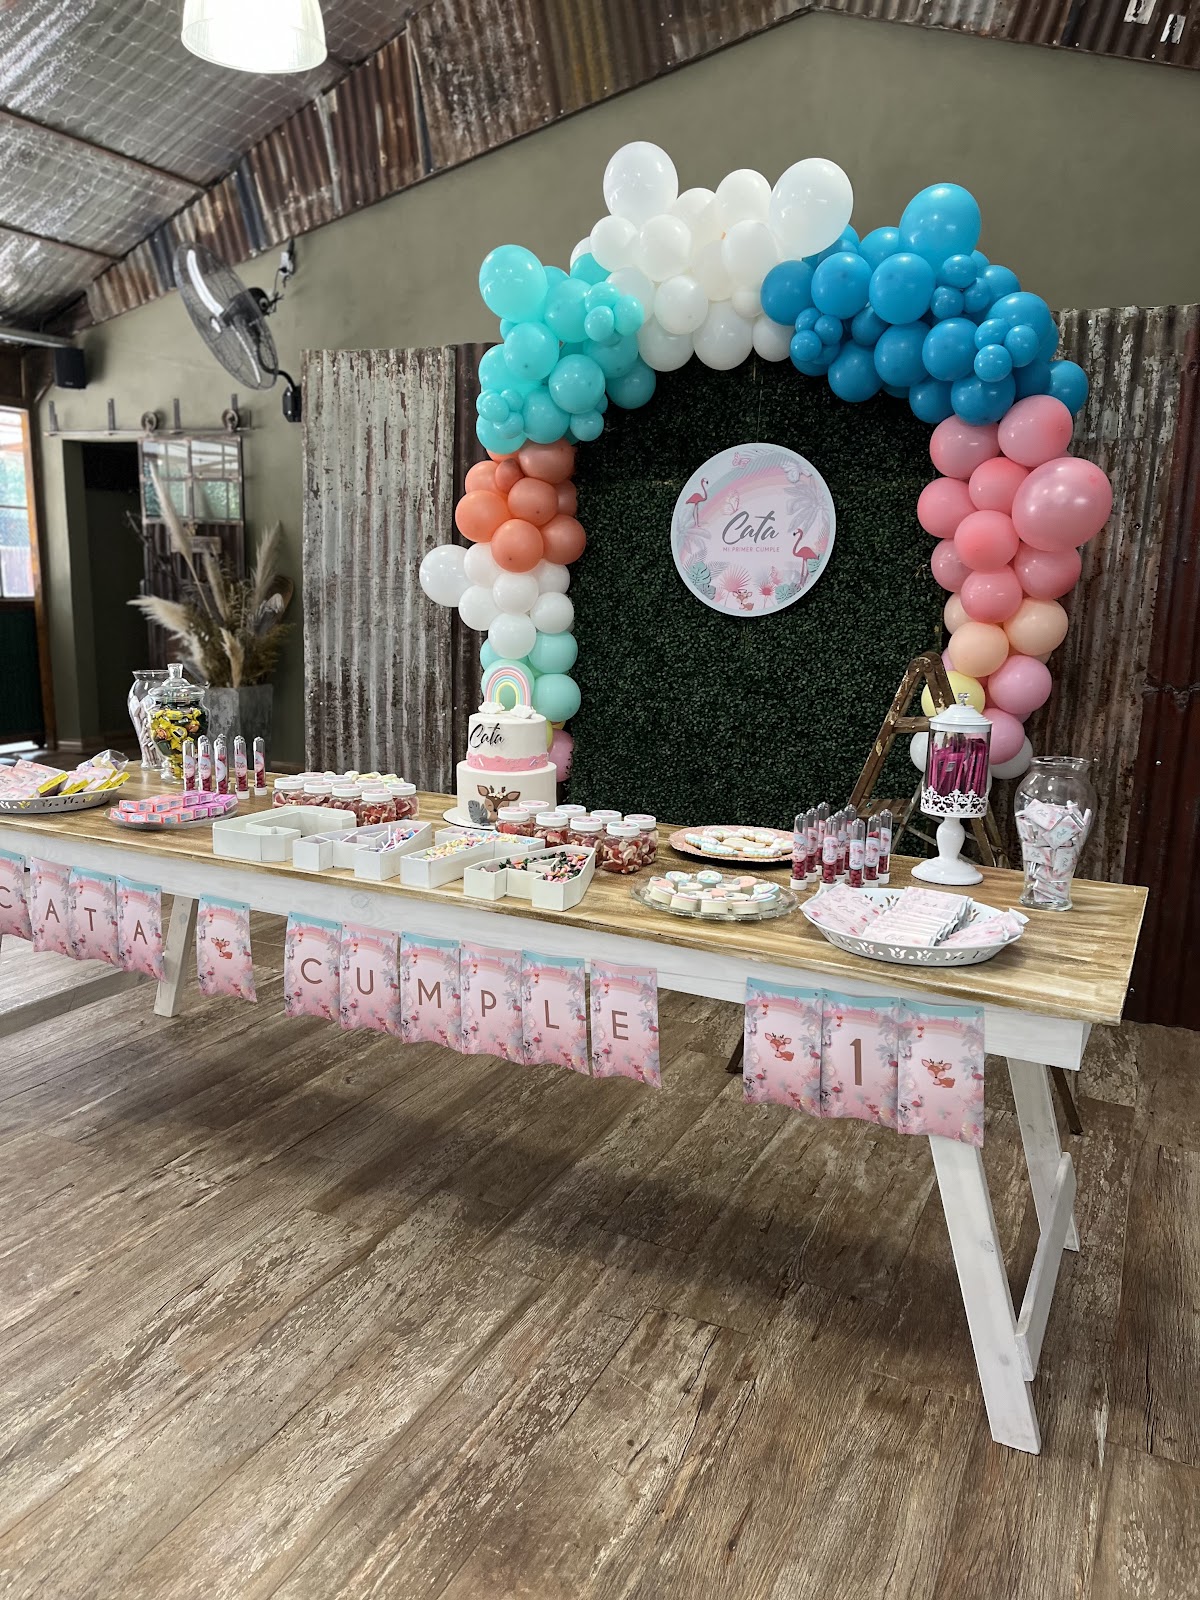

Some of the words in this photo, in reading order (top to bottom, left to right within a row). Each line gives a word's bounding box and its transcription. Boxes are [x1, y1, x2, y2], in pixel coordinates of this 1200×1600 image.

[722, 510, 779, 545] Cata
[469, 723, 505, 748] Cata
[300, 957, 629, 1041] CUMPLE
[849, 1038, 863, 1087] 1
